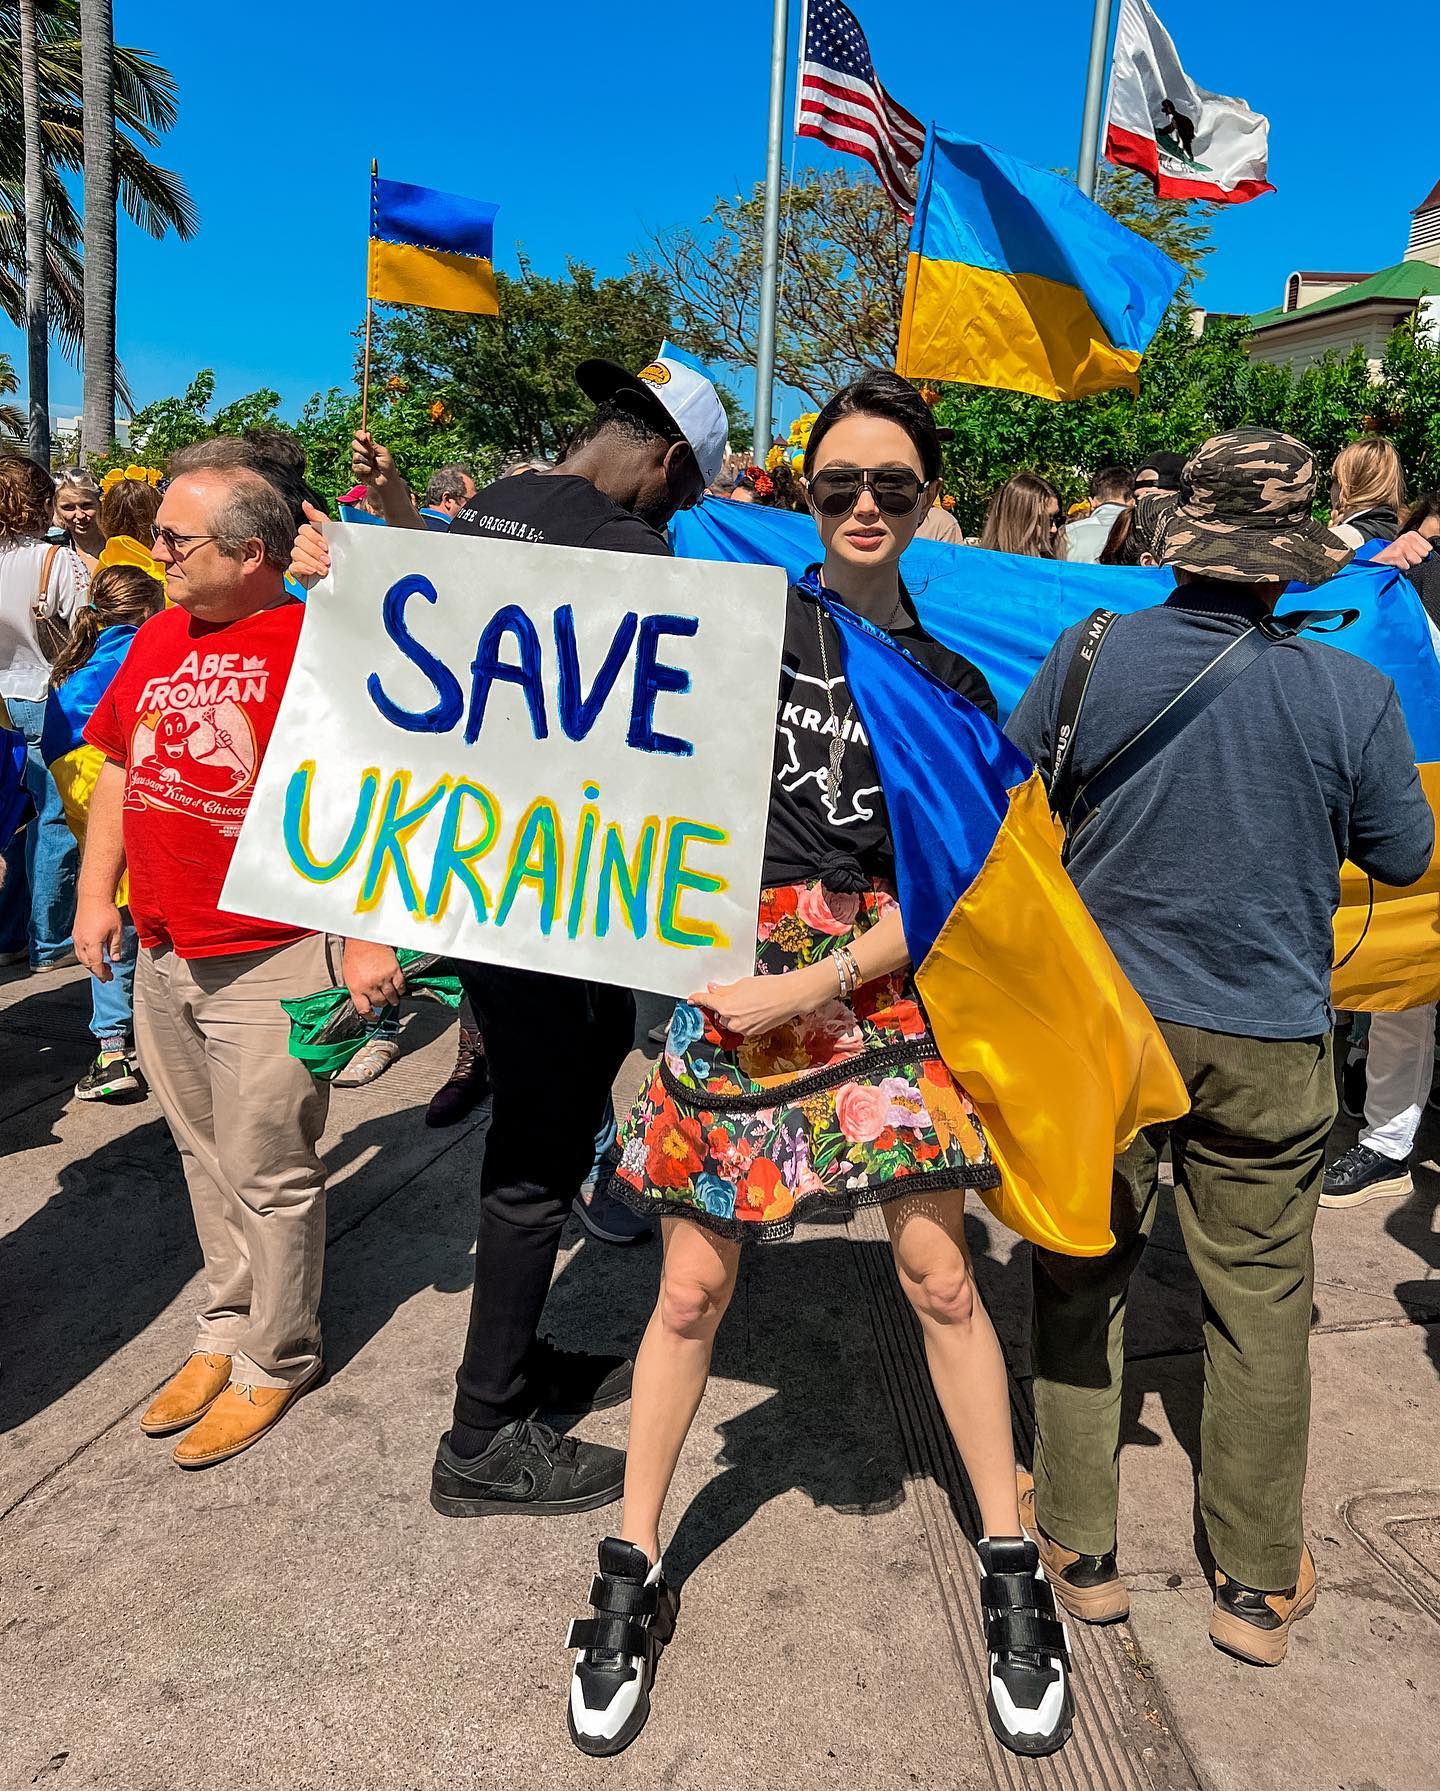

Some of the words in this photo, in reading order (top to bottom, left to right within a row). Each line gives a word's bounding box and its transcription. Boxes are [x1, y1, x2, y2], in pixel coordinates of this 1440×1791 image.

[480, 515, 536, 540] ORIGINAL
[169, 650, 269, 683] ABE
[367, 573, 699, 756] SAVE
[135, 676, 267, 713] FROMAN
[777, 700, 868, 746] KRAIN
[162, 783, 193, 806] King
[202, 801, 247, 817] Chicag
